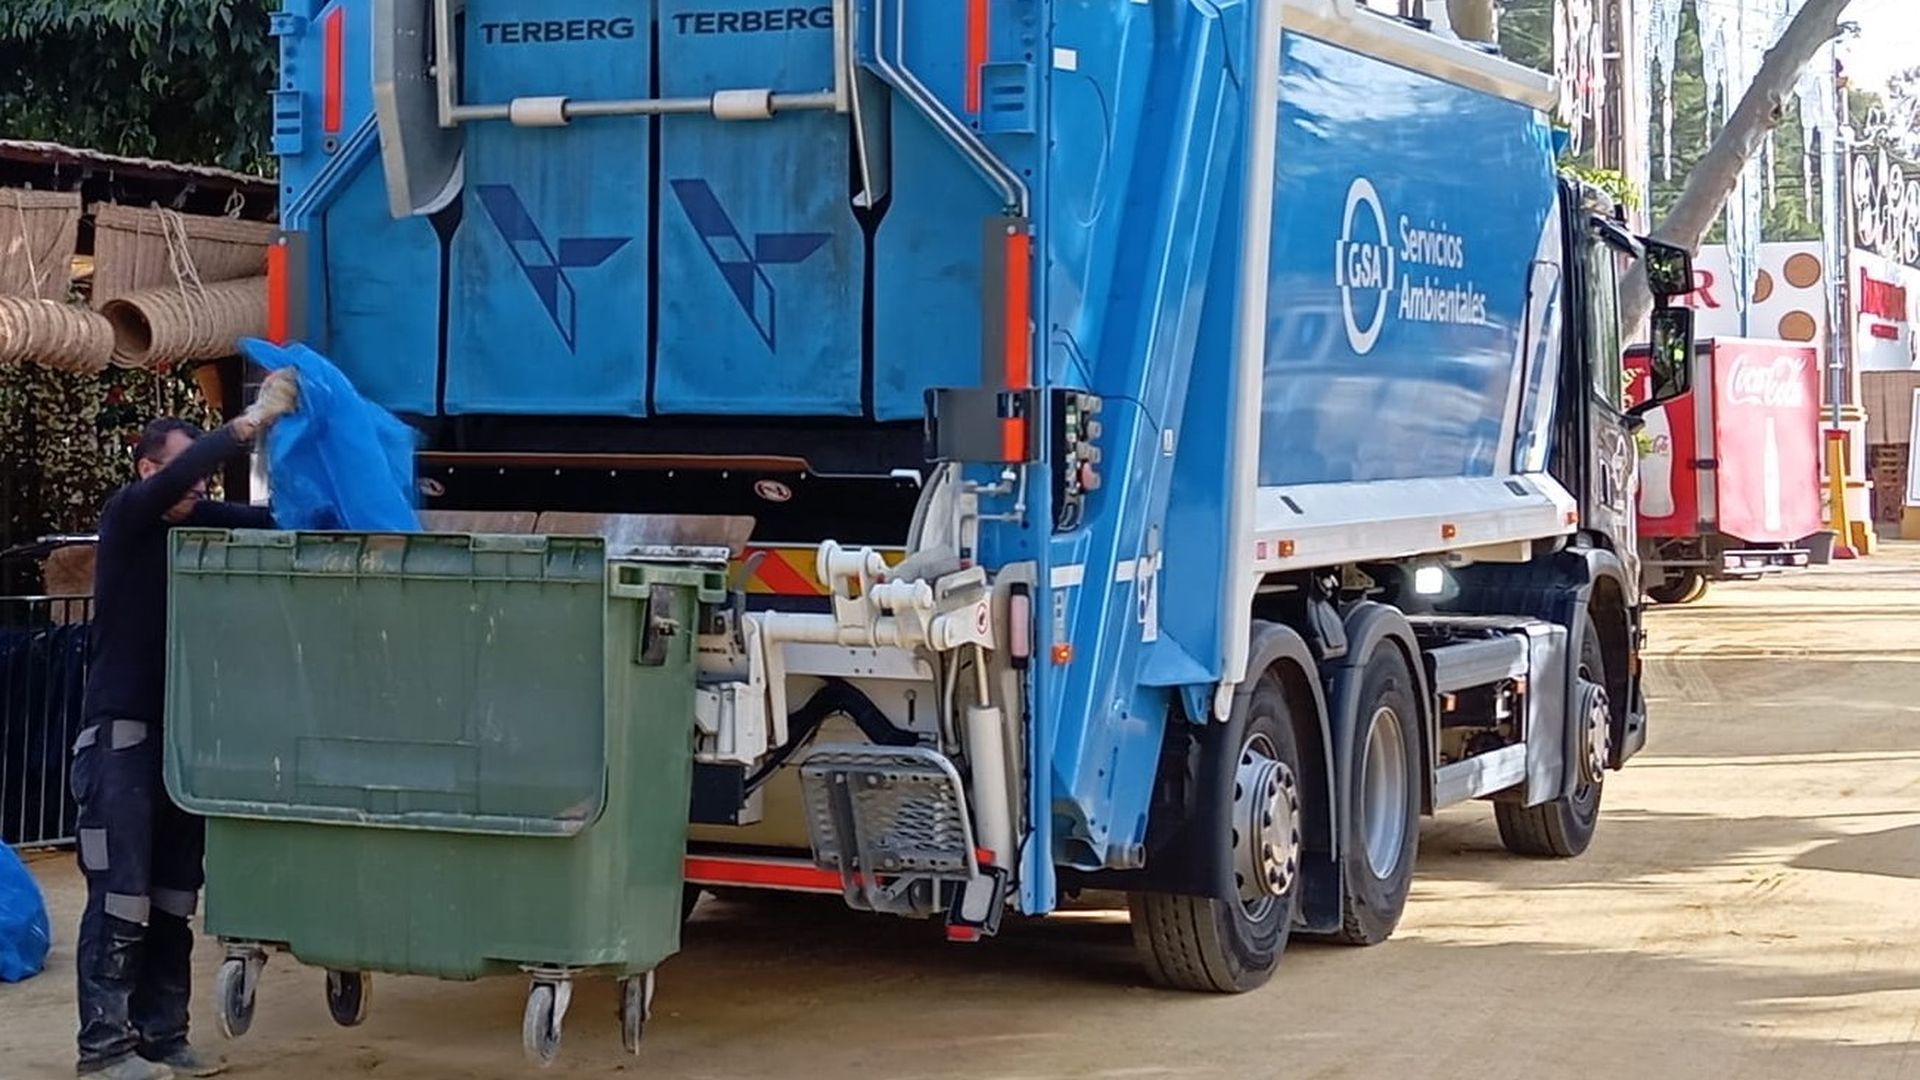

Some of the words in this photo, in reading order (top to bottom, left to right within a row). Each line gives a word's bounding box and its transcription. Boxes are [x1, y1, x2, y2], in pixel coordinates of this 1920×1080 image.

[480, 18, 634, 44] TERBERG
[672, 6, 833, 34] TERBERG
[1348, 242, 1382, 288] GSA
[1400, 215, 1463, 269] Servicios
[1398, 273, 1486, 324] Ambientales
